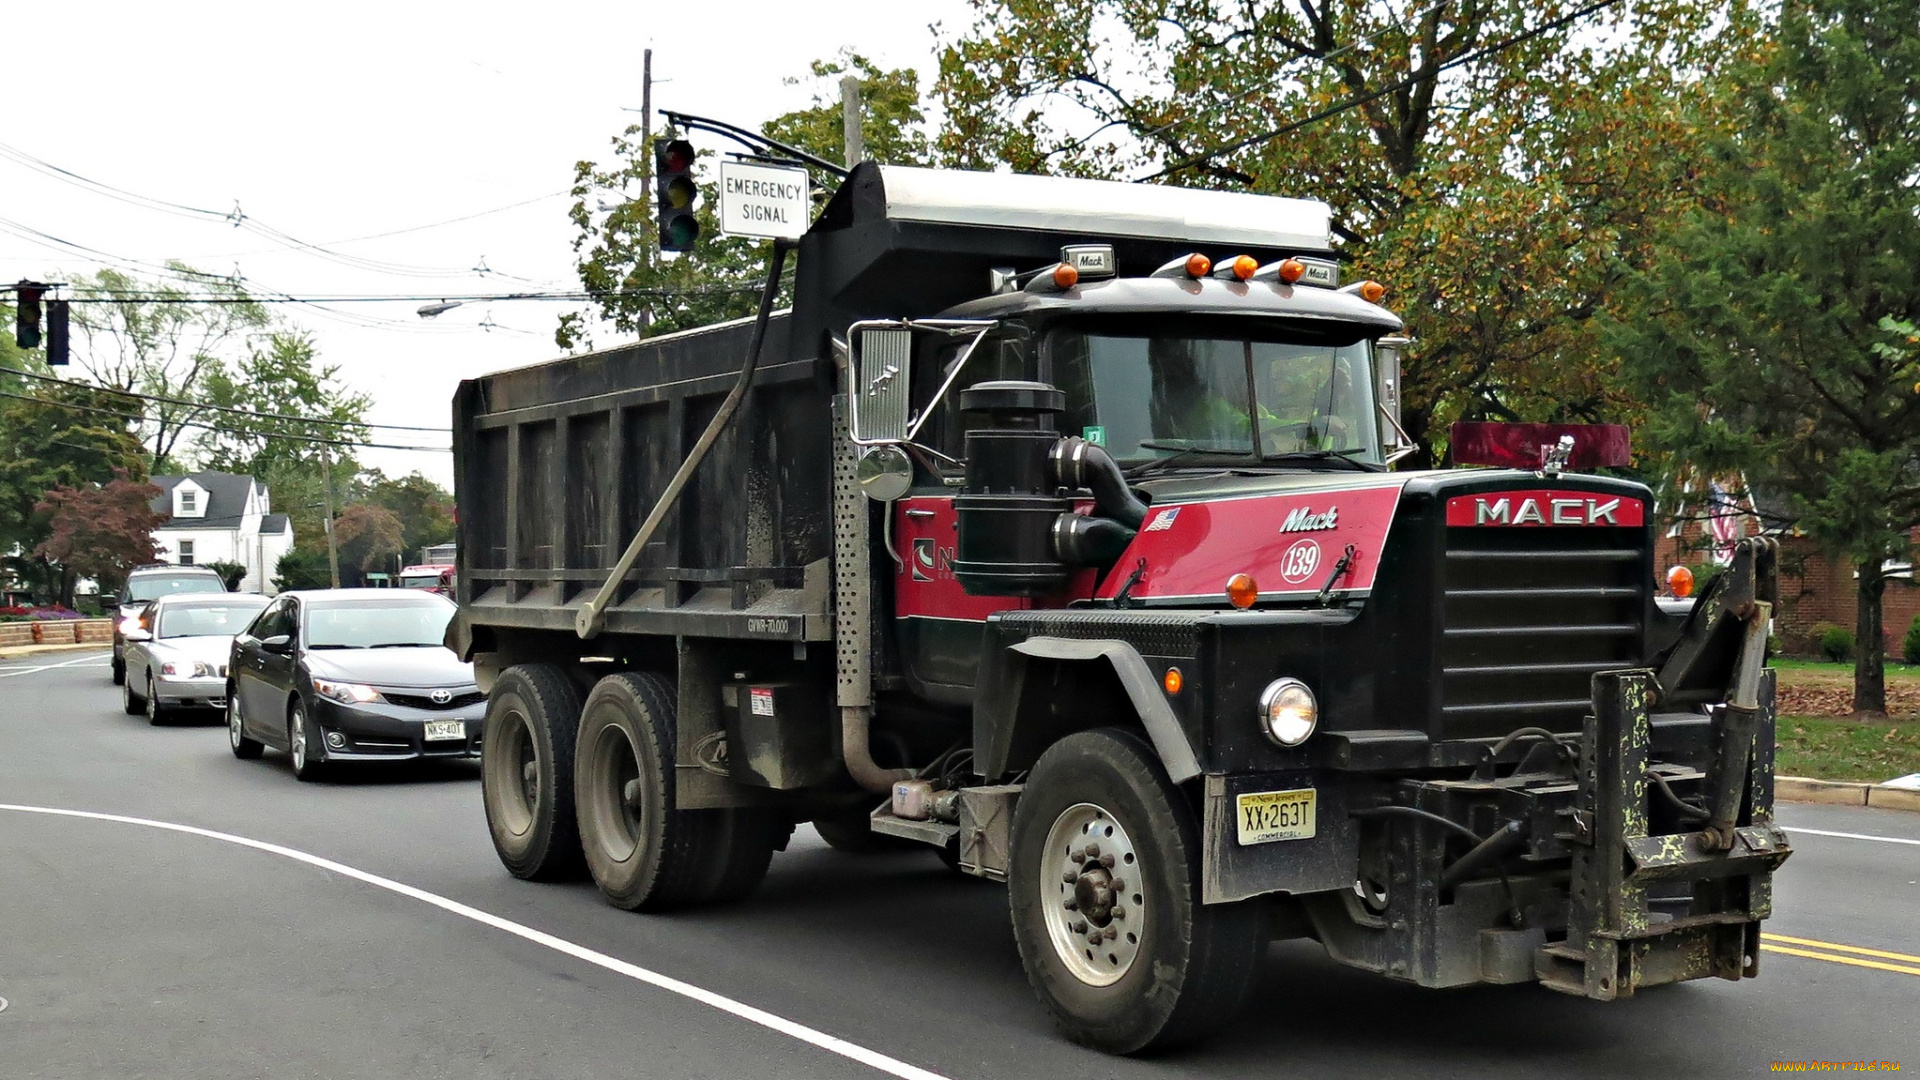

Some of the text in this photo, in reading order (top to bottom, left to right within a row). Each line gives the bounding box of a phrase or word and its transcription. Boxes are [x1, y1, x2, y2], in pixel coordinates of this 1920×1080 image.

[726, 177, 802, 201] EMERGENCY
[742, 204, 788, 224] SIGNAL
[1080, 255, 1103, 267] Mack
[1307, 267, 1329, 280] Mack
[1279, 505, 1338, 533] Mack
[1475, 498, 1620, 525] MACK
[1284, 545, 1318, 576] 139
[1257, 793, 1296, 803] New Jersey
[1257, 831, 1298, 841] COMMERCIAL
